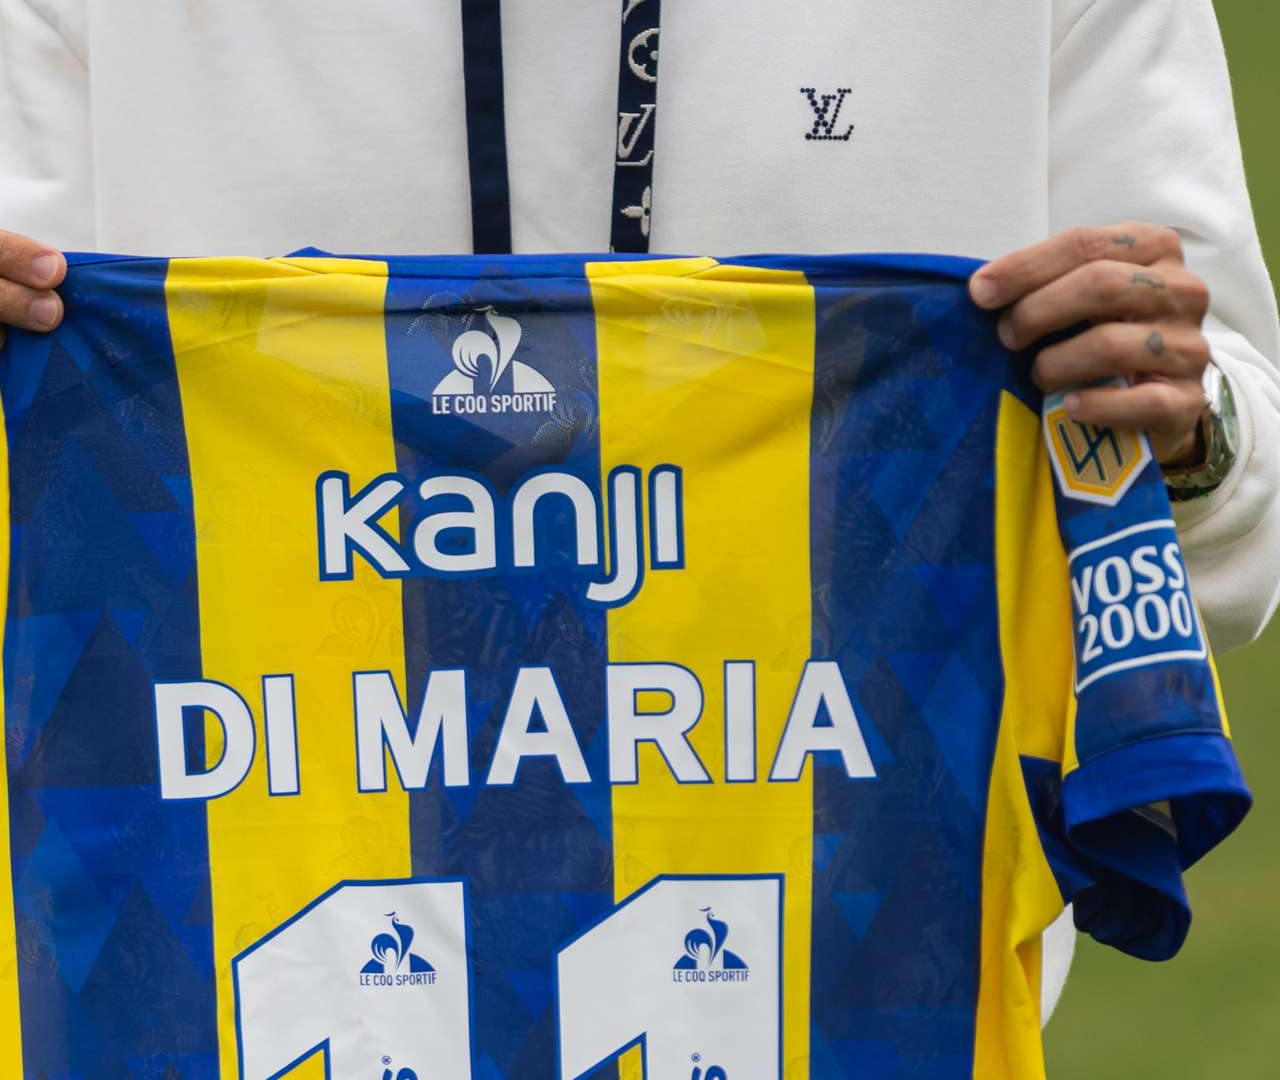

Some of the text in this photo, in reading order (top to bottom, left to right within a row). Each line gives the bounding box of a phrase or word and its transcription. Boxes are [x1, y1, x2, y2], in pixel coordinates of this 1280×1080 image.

[432, 393, 557, 415] LE COQ SPORTIF
[1071, 542, 1185, 616] VOSS
[1079, 589, 1193, 664] 2000
[153, 659, 877, 801] DI MARIA
[359, 973, 438, 986] LE COQ SPORTIF
[672, 970, 751, 983] LE COQ SPORTIF
